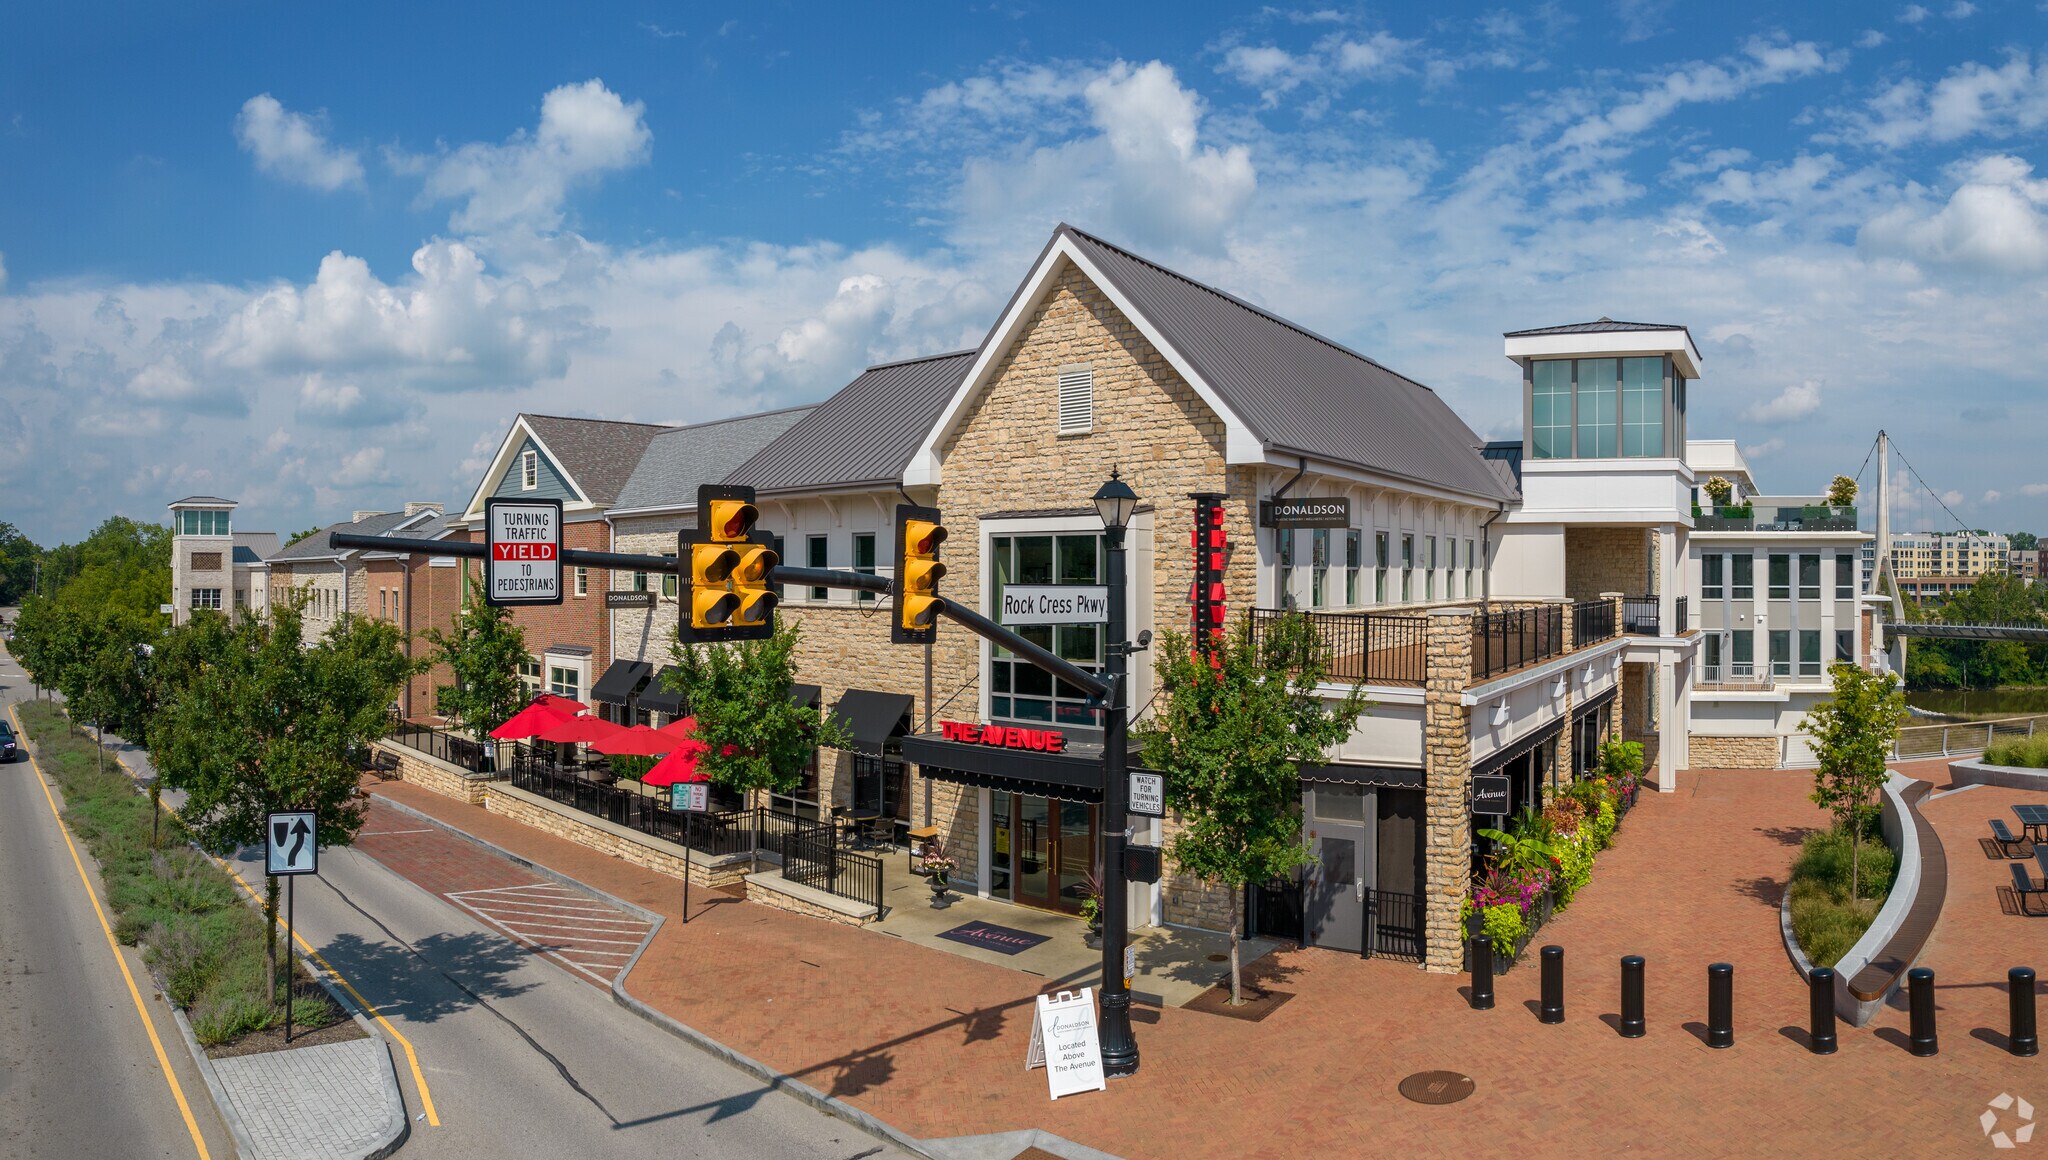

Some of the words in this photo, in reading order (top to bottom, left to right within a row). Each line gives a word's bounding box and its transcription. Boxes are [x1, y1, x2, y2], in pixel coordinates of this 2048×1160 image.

[1275, 505, 1345, 515] DONALDSON
[503, 513, 549, 525] TURNING
[505, 527, 547, 540] TRAFFIC
[499, 544, 552, 559] YIELD
[521, 564, 532, 576] TO
[498, 577, 555, 591] PEDESTRIANS
[1004, 594, 1034, 614] Rock
[1040, 594, 1072, 614] Cress
[1077, 594, 1105, 618] Pkwy
[939, 720, 979, 743] THE
[980, 725, 1063, 752] AVENUE
[1136, 776, 1156, 785] WATCH
[1140, 785, 1152, 793] FOR
[1474, 788, 1507, 801] Avenue
[1133, 792, 1159, 803] TURNING
[1132, 801, 1160, 811] VEHICLES
[950, 928, 1036, 945] Avenue
[1057, 1020, 1090, 1031] DONALDSON
[1058, 1040, 1086, 1051] Located
[1062, 1052, 1085, 1061] Above
[1054, 1065, 1068, 1073] The
[1069, 1060, 1096, 1070] Avenue
